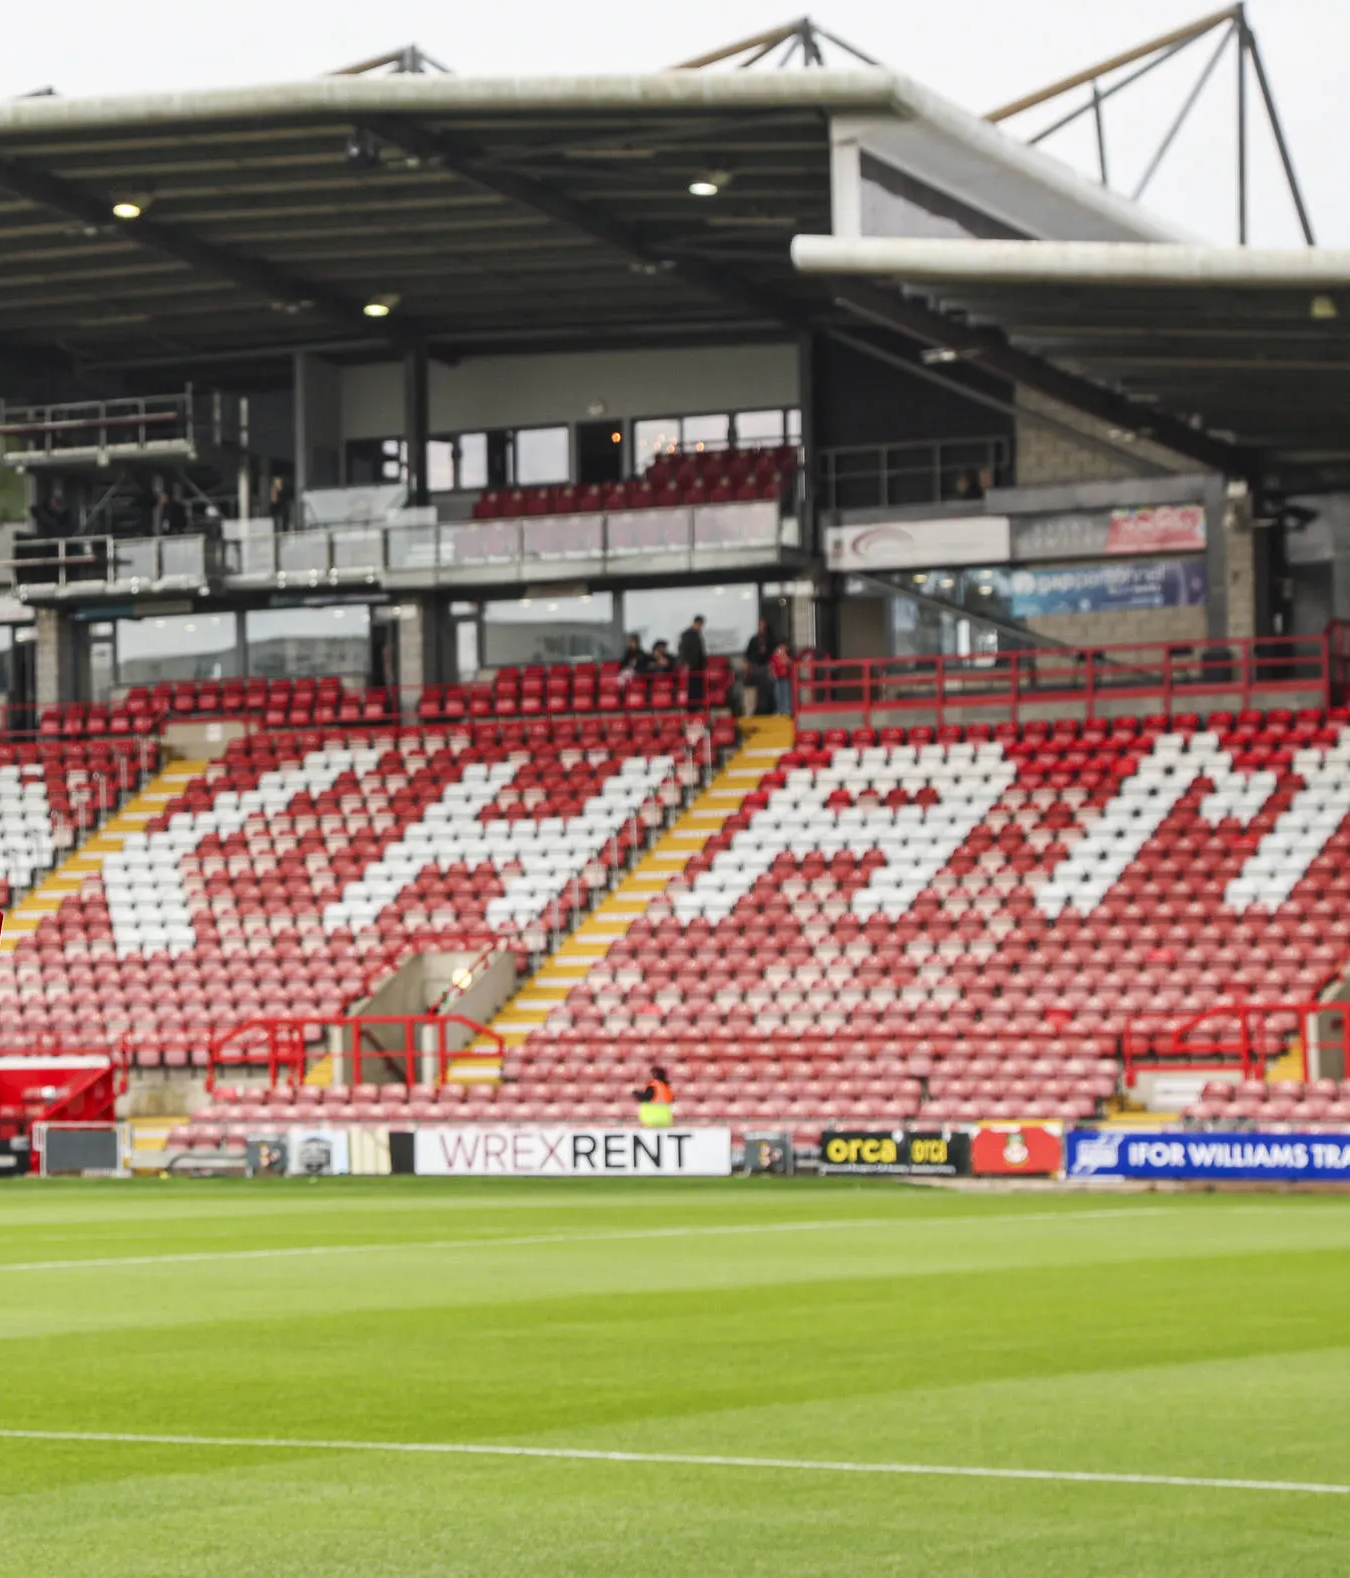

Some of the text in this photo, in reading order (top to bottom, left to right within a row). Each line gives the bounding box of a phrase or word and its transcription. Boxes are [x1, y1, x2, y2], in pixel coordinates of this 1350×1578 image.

[439, 1134, 692, 1170] WREXRENT
[826, 1137, 898, 1163] orca
[1128, 1142, 1186, 1168] IFOR
[1186, 1142, 1310, 1169] WILLIAMS
